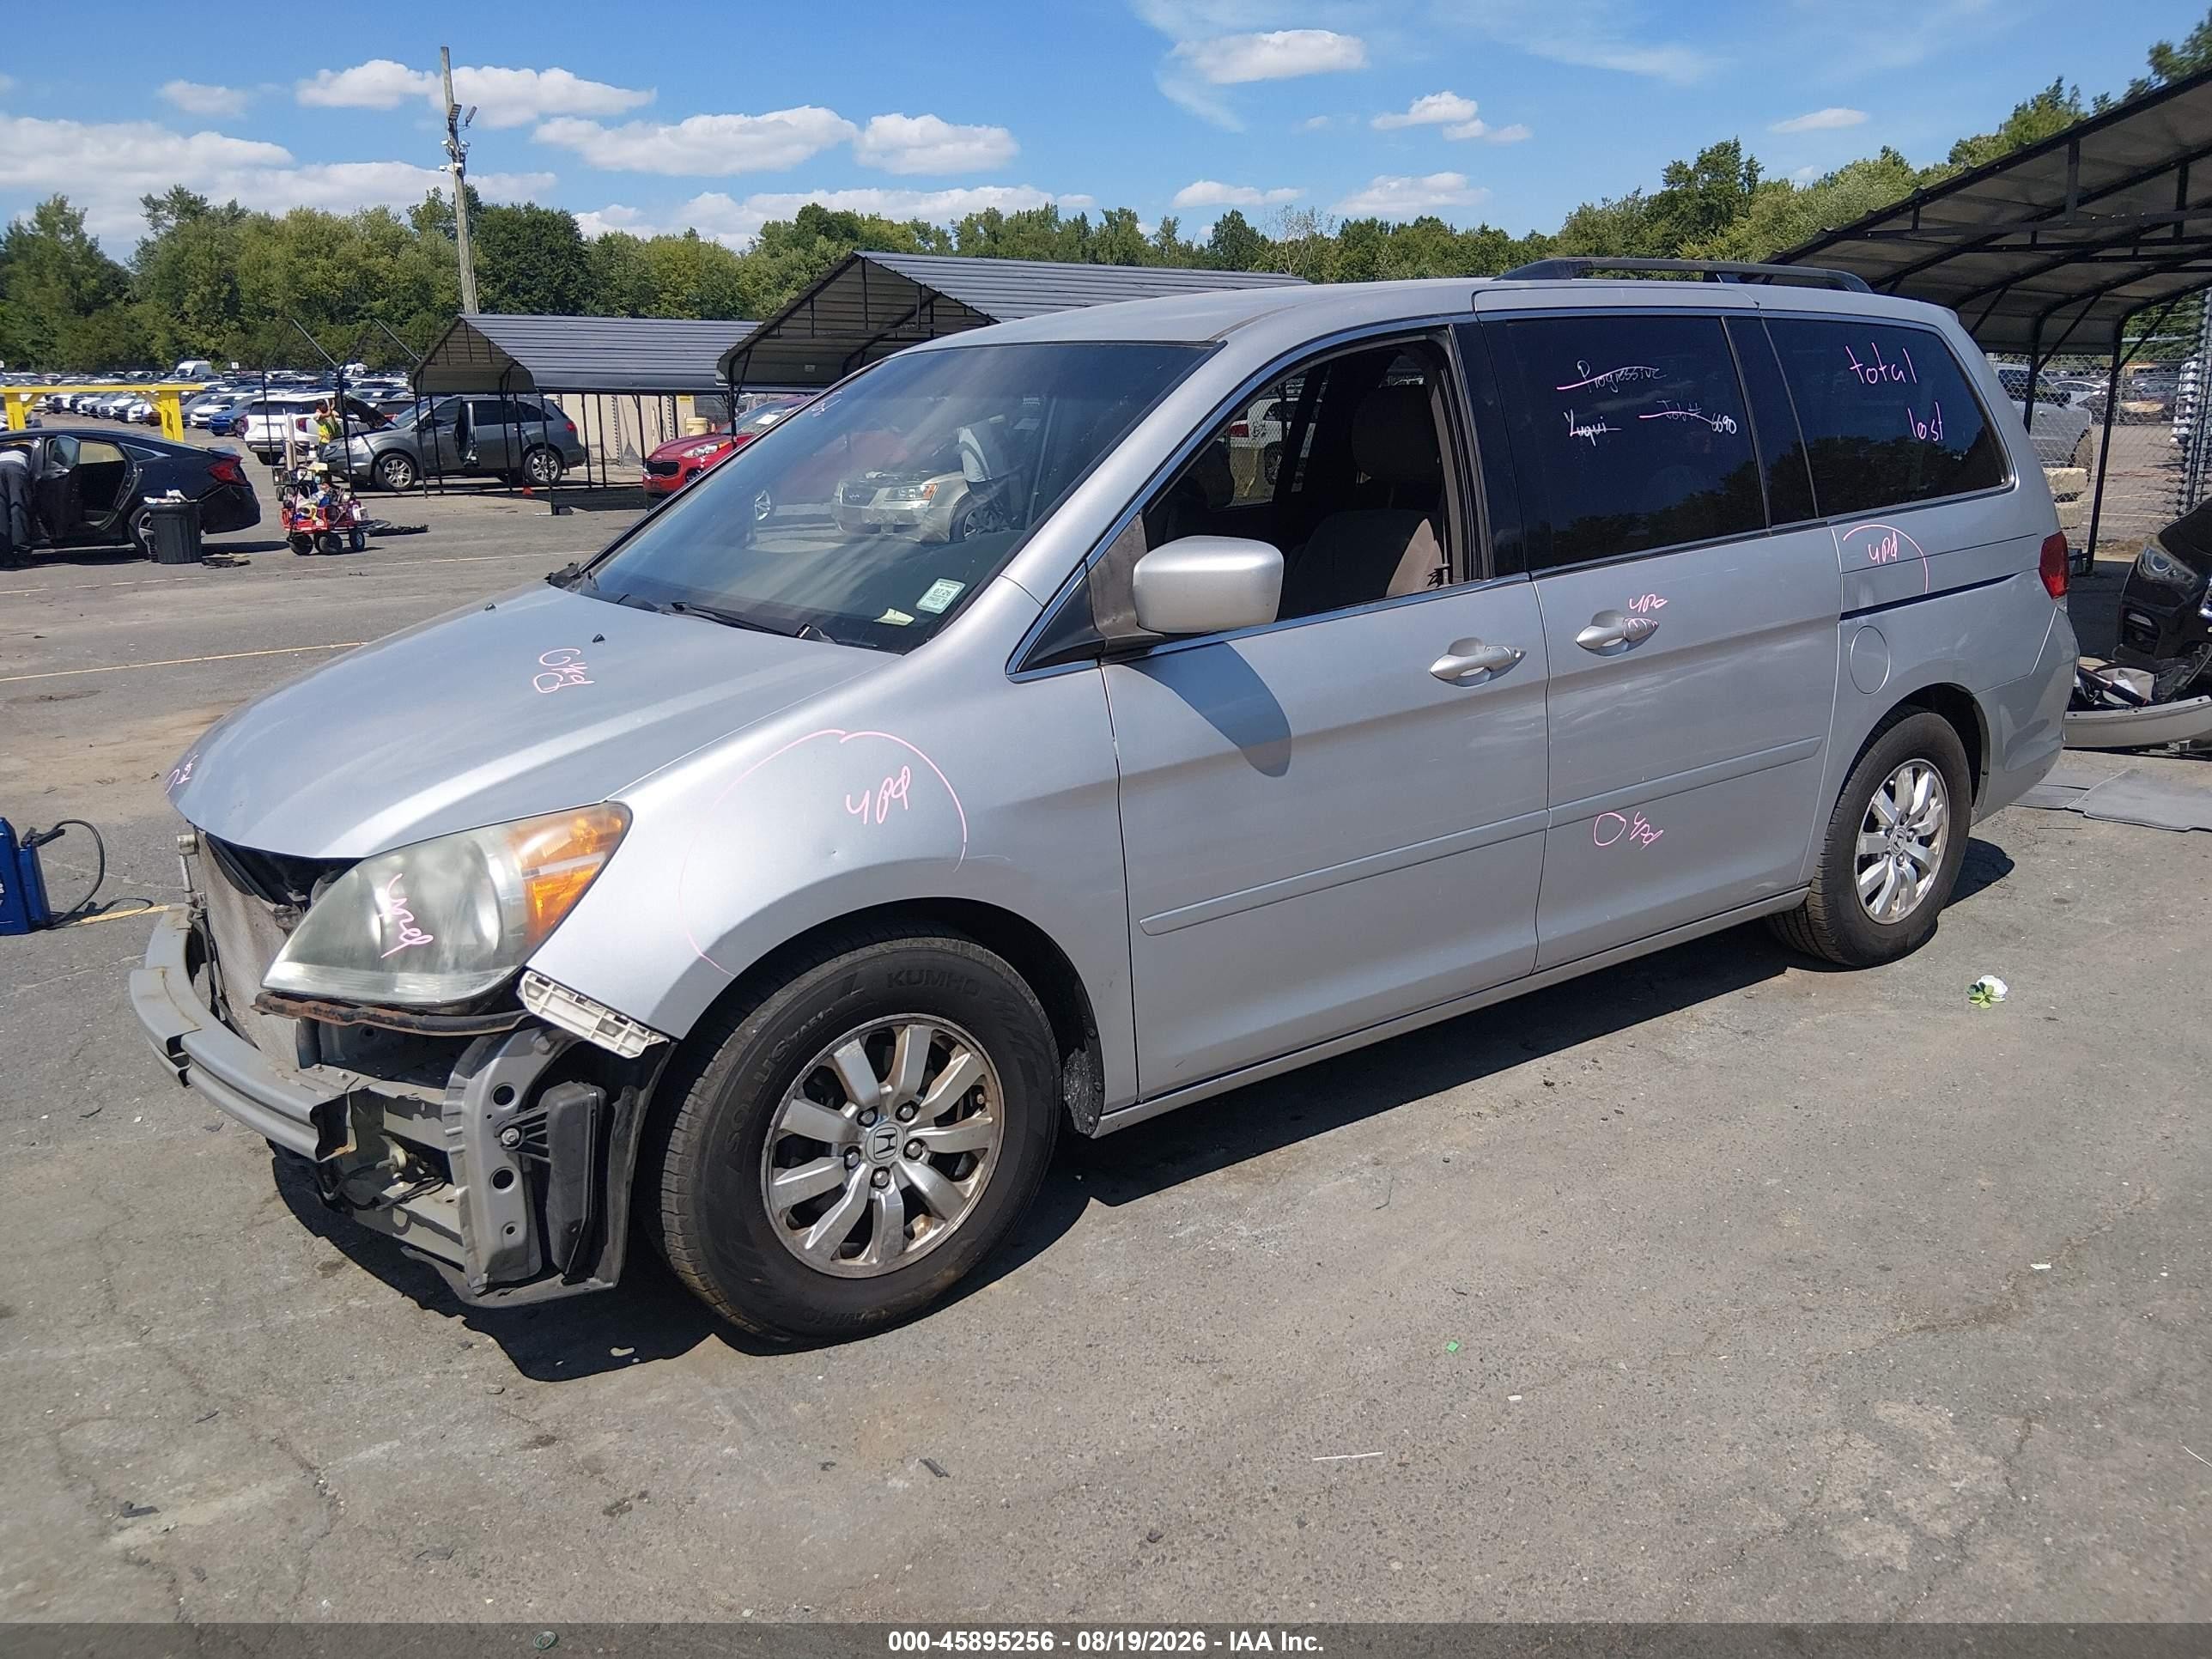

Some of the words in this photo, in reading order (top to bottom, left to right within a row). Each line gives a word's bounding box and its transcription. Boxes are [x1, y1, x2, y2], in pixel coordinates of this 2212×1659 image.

[1577, 360, 1667, 393] Progressive
[1844, 342, 1917, 385] total
[1907, 401, 1944, 441] lost
